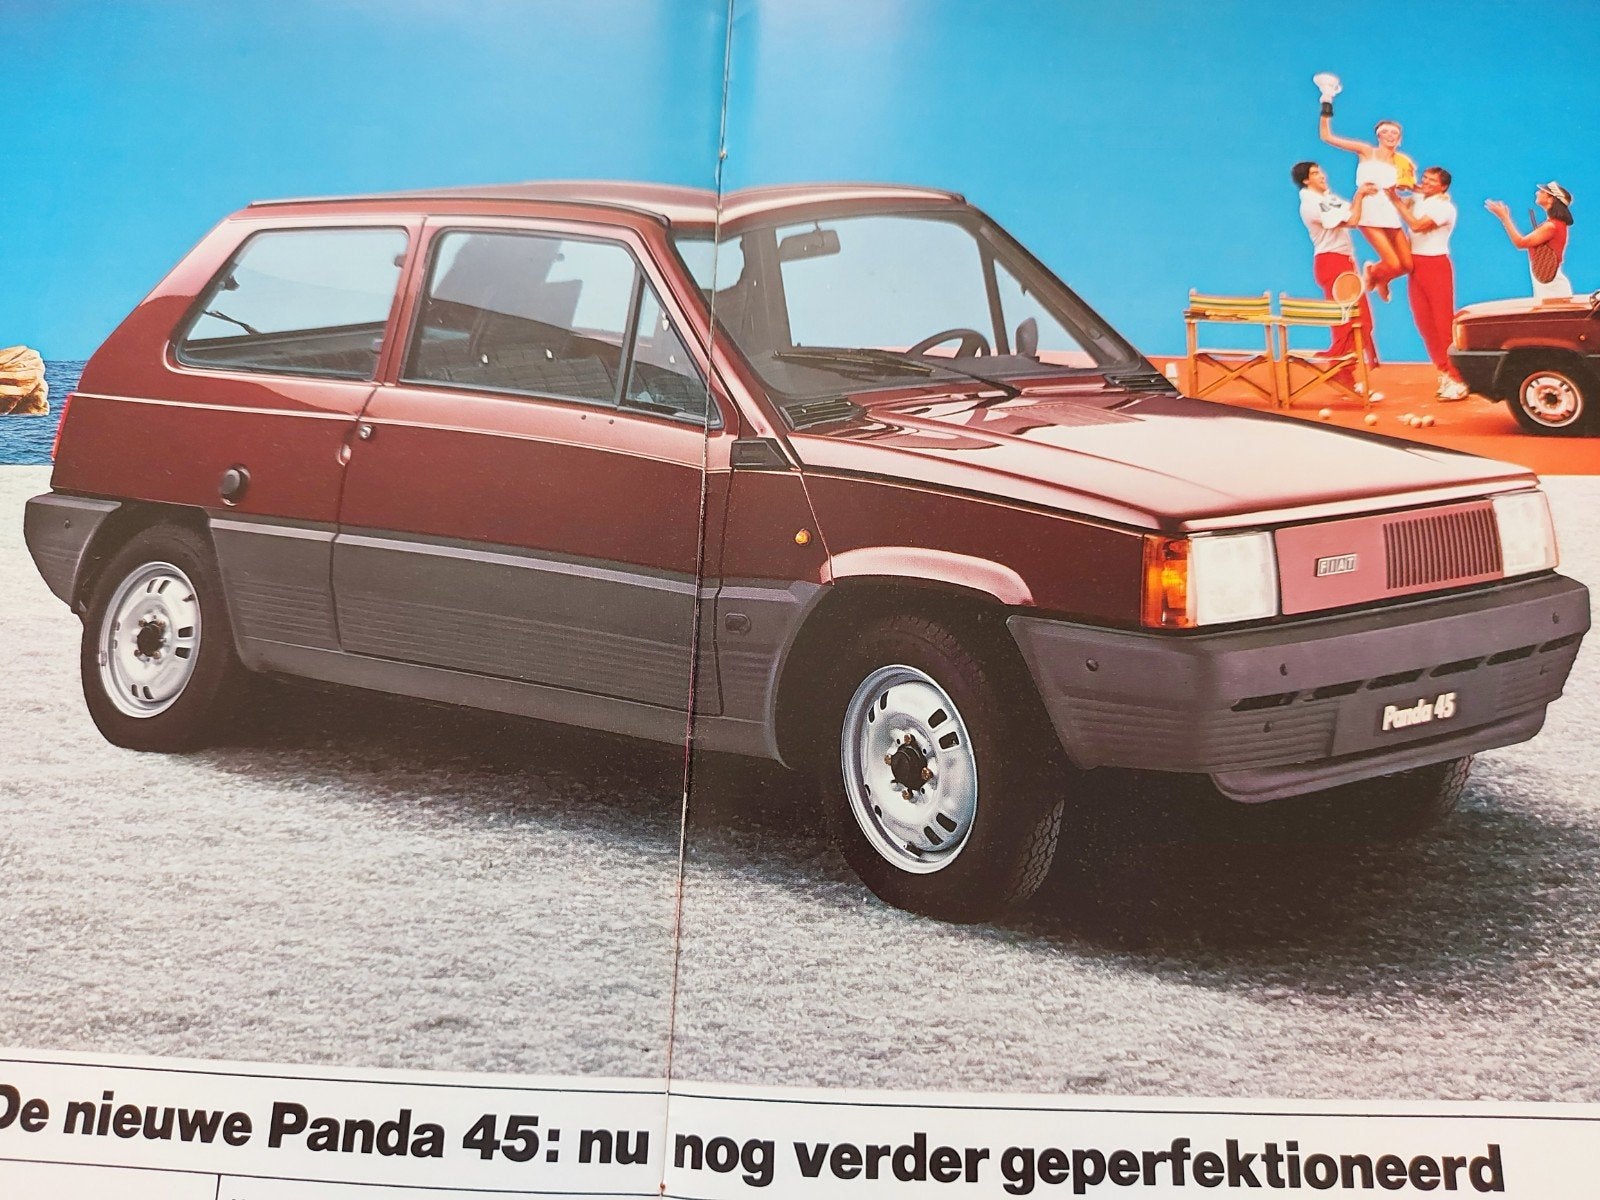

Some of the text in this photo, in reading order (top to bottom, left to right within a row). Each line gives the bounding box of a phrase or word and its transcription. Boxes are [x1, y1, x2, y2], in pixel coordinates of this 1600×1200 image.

[1319, 556, 1355, 575] FIAT
[1382, 692, 1457, 730] Panda 45
[63, 1090, 253, 1147] nieuwe
[267, 1101, 445, 1159] Panda
[462, 1114, 560, 1163] 45:
[578, 1129, 650, 1165] nu
[673, 1134, 775, 1188] nog
[793, 1132, 990, 1184] verder
[1000, 1137, 1505, 1196] geperfektioneerd
